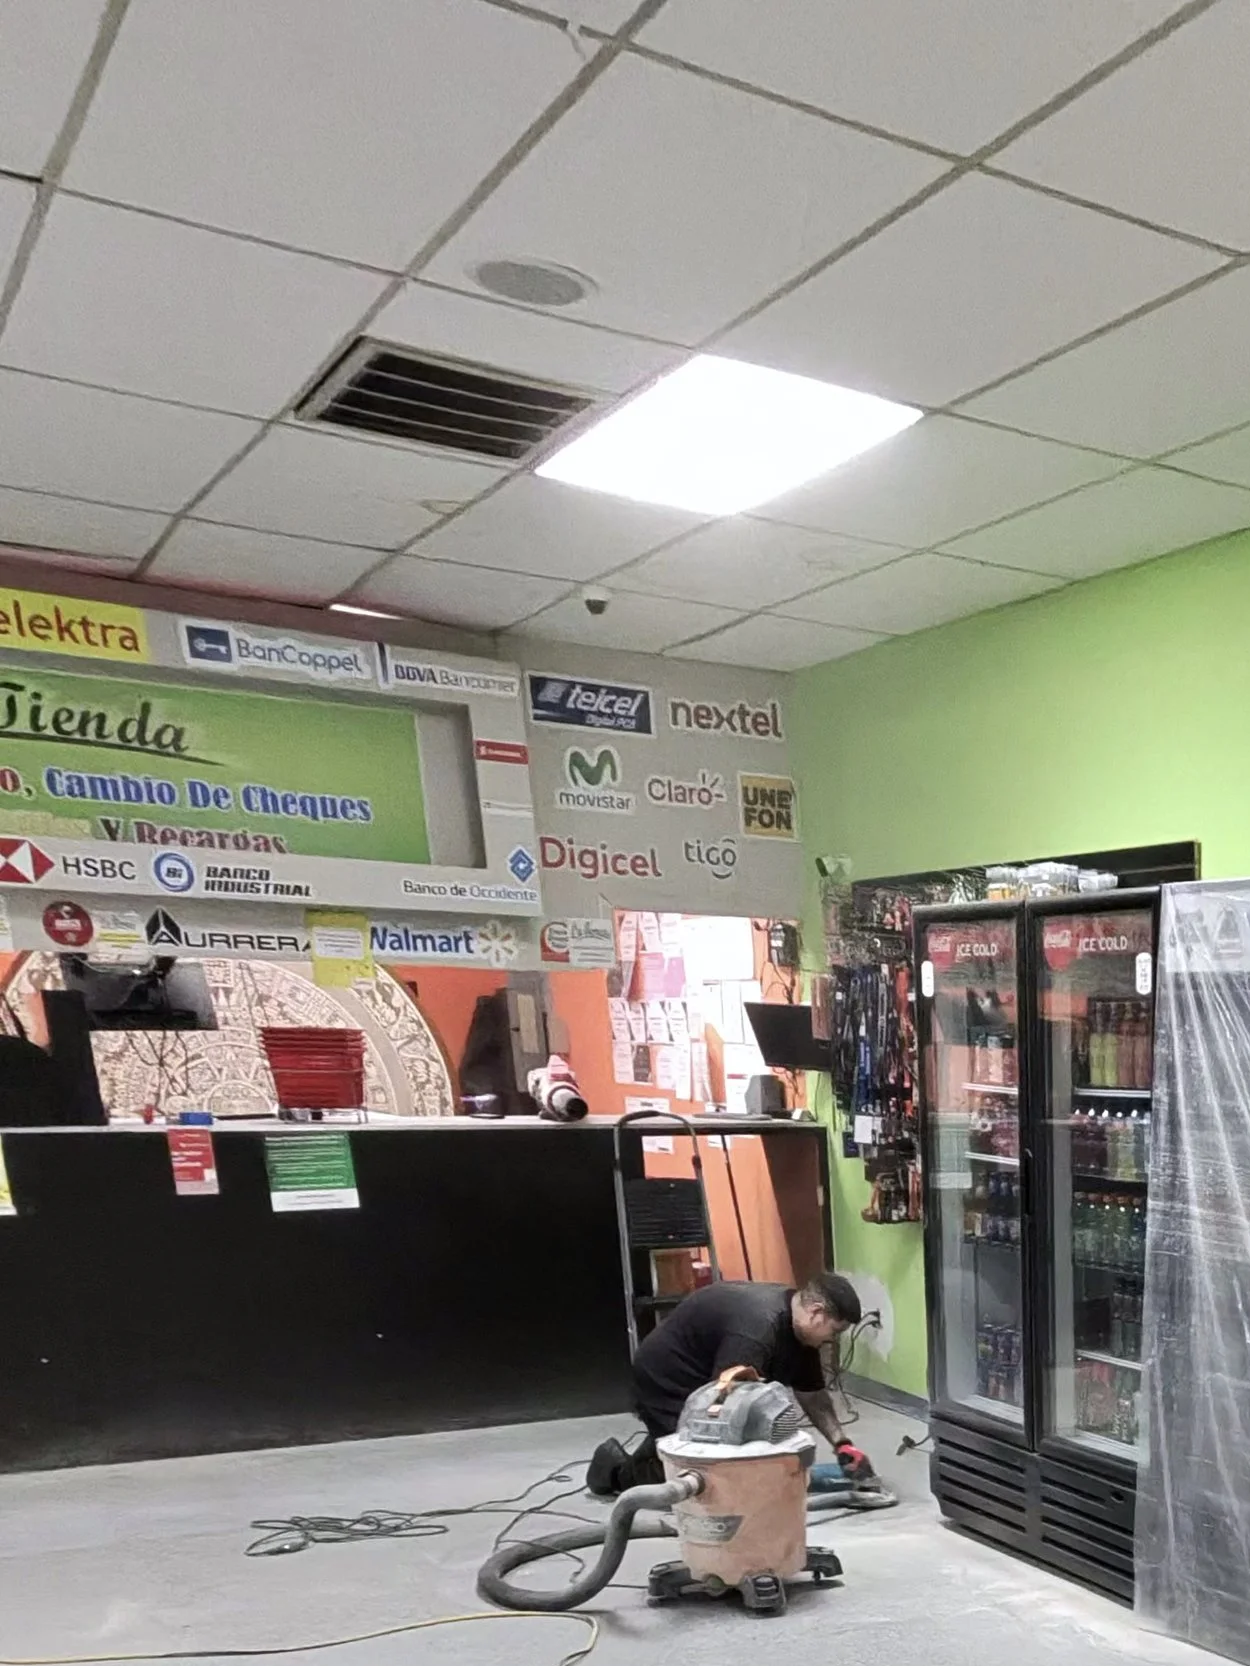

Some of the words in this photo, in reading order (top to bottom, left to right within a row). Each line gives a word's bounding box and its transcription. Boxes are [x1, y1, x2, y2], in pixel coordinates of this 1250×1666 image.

[236, 638, 363, 673] BanCoppel
[566, 684, 644, 716] telcel
[0, 681, 189, 752] Tienda
[671, 702, 782, 738] nextel
[46, 767, 176, 806] Cambio
[188, 780, 232, 810] De
[243, 785, 372, 824] Cheques
[559, 791, 631, 810] movistar
[648, 778, 713, 806] Claro
[742, 787, 792, 809] UNE
[744, 808, 793, 830] FON
[540, 836, 662, 879] Digicel
[684, 842, 737, 866] tigo
[62, 856, 136, 881] HSBC
[207, 866, 271, 881] BANCO
[205, 879, 312, 897] INDUSTRIAL
[403, 880, 448, 896] Banco
[450, 884, 467, 897] de
[470, 885, 537, 901] Occidente
[956, 943, 972, 957] ICE
[972, 942, 997, 957] COLD
[1079, 937, 1097, 952] ICE
[1099, 935, 1128, 951] COLD
